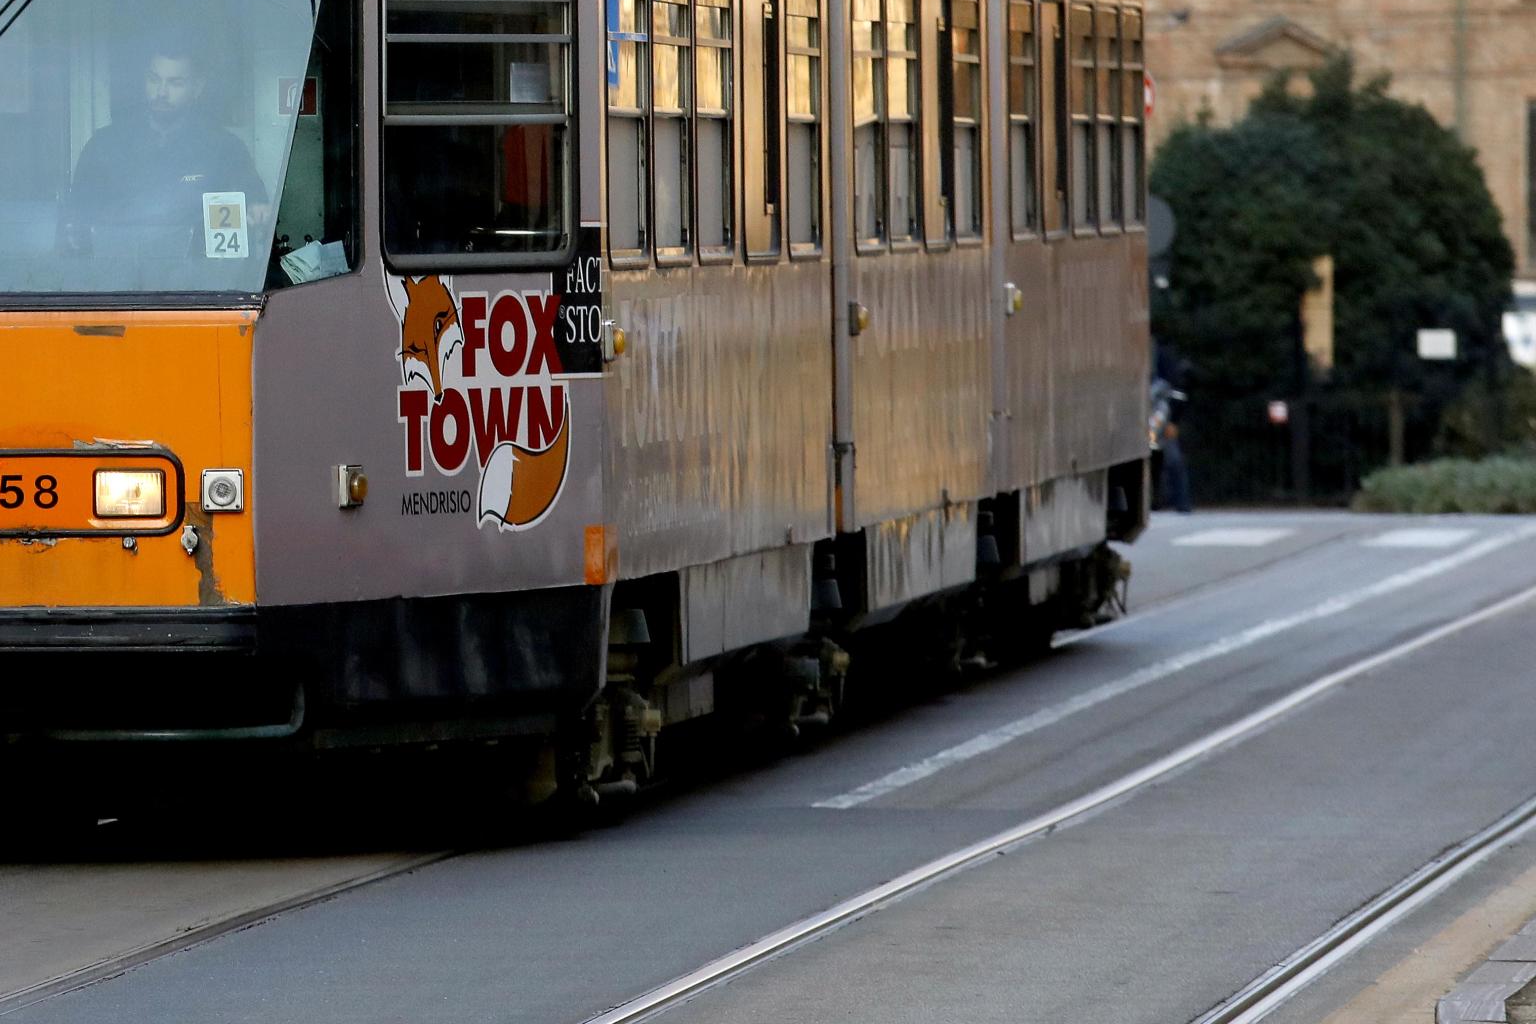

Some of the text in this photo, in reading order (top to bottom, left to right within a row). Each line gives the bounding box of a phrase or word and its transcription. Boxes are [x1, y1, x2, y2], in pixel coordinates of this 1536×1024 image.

[218, 206, 232, 228] 2
[214, 232, 240, 253] 24
[461, 294, 563, 377] FOX
[400, 385, 563, 472] TOWN
[401, 490, 471, 515] MENDRISIO
